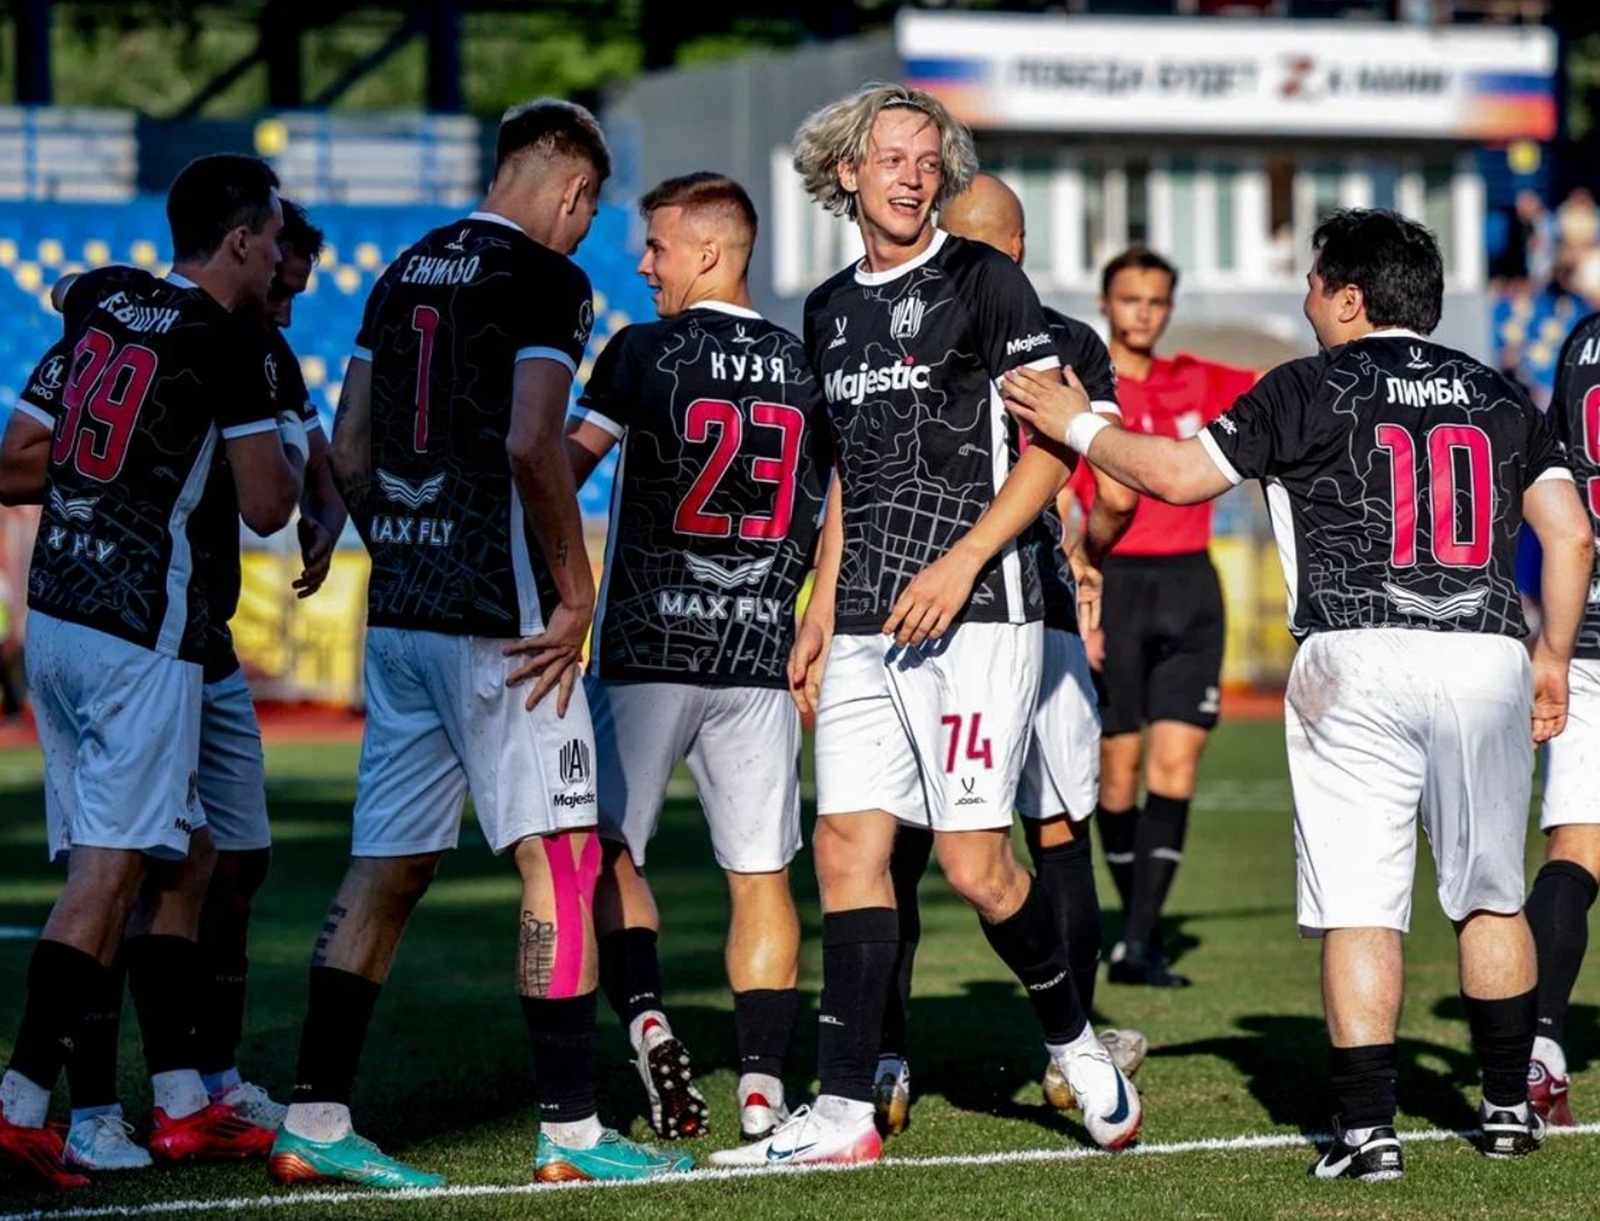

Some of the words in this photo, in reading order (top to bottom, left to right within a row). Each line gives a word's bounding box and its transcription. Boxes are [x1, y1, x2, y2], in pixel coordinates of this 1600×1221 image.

[412, 305, 440, 453] 1
[710, 351, 786, 384] КУЗЯ
[825, 356, 931, 406] Majestic
[1385, 377, 1470, 408] ЛИМБА
[53, 326, 159, 484] 99
[673, 397, 805, 542] 23
[1375, 422, 1493, 570] 10
[418, 519, 455, 547] FLY
[658, 590, 729, 620] MAX
[735, 596, 781, 623] FLY
[940, 711, 993, 773] 74
